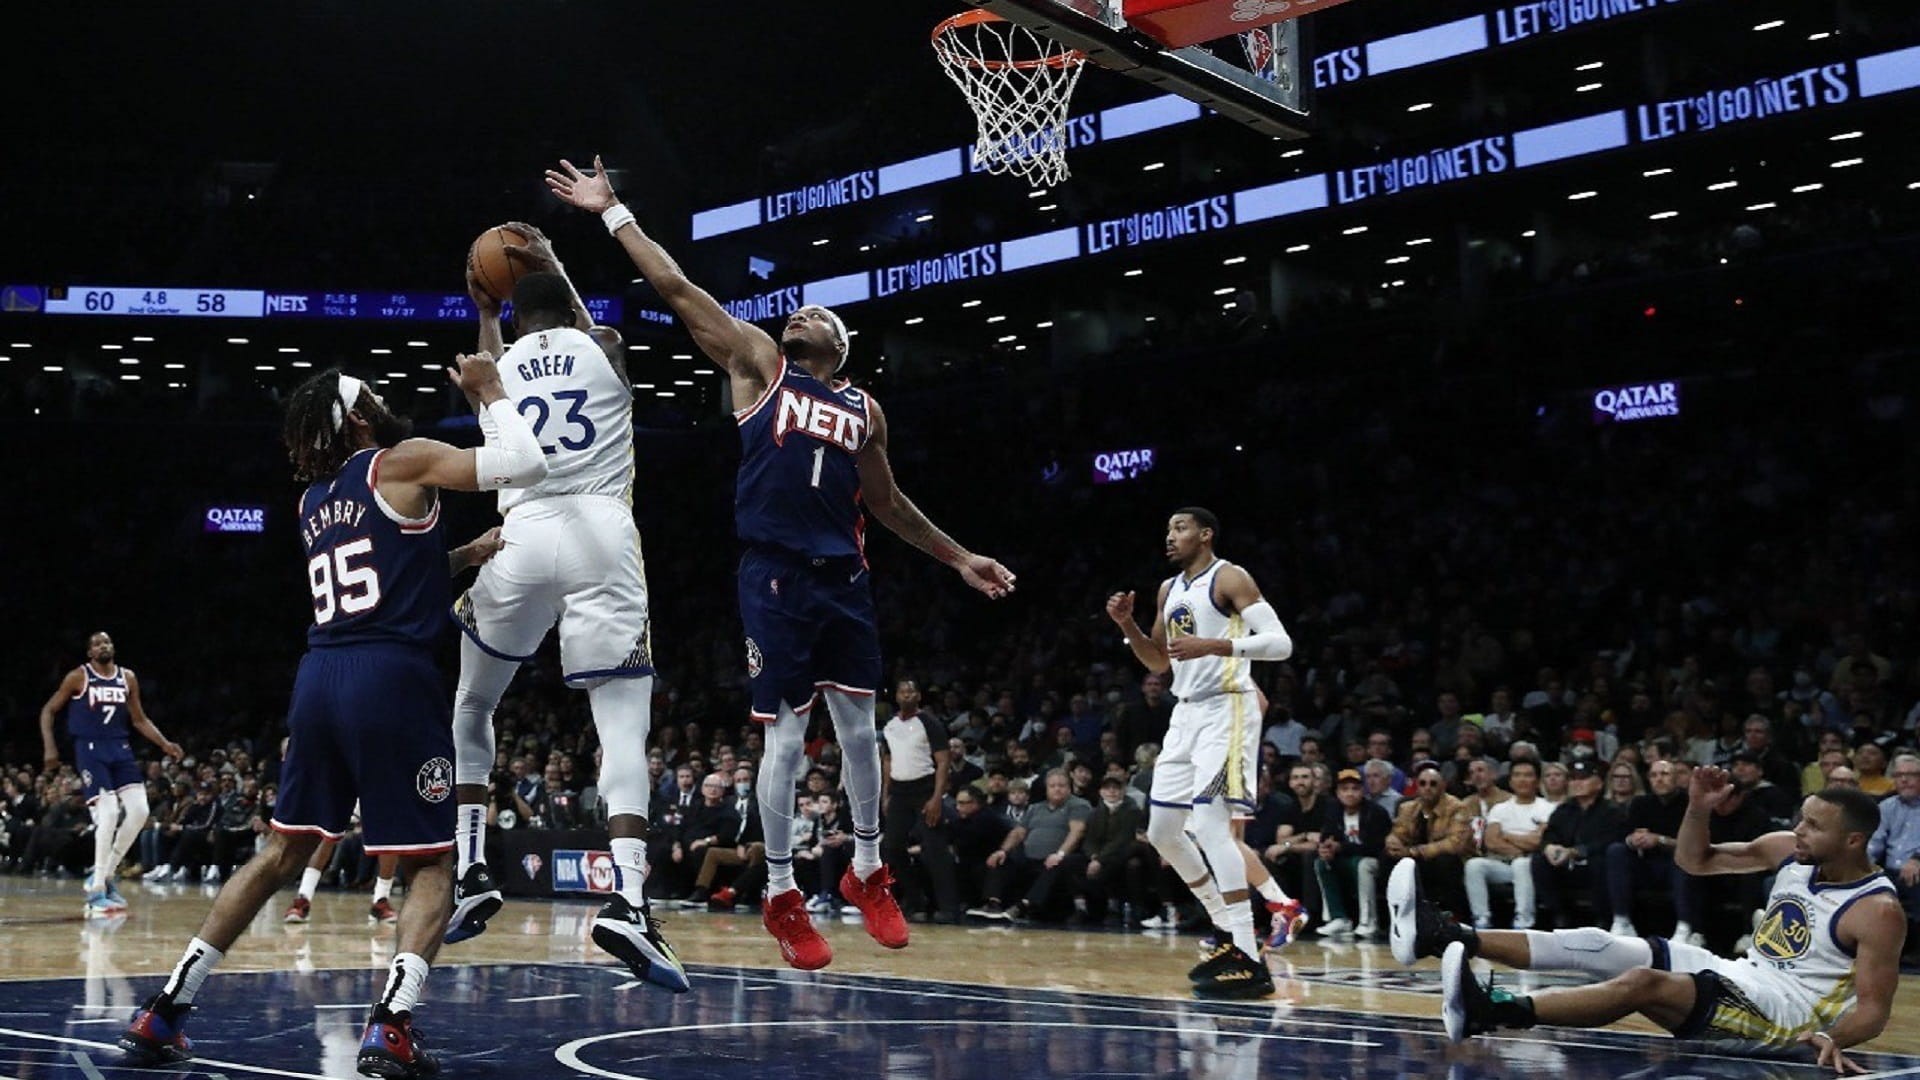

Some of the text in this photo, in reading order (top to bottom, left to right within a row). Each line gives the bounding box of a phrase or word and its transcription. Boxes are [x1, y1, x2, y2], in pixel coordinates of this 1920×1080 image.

[1314, 47, 1360, 88] ETS
[85, 291, 114, 311] 60
[142, 291, 167, 305] 4.8
[196, 293, 226, 312] 58
[266, 294, 309, 316] NETS
[517, 354, 575, 382] GREEN
[1595, 381, 1677, 414] QATAR
[517, 389, 597, 455] 23
[775, 388, 866, 452] NETS
[811, 446, 825, 487] 1
[1094, 449, 1152, 473] QATAR
[207, 507, 264, 525] QATAR
[302, 500, 366, 549] BEMBRY
[308, 537, 381, 625] 95
[88, 685, 126, 707] NETS
[102, 704, 116, 725] 7
[556, 858, 613, 882] NBA TNT
[1784, 918, 1807, 943] 30
